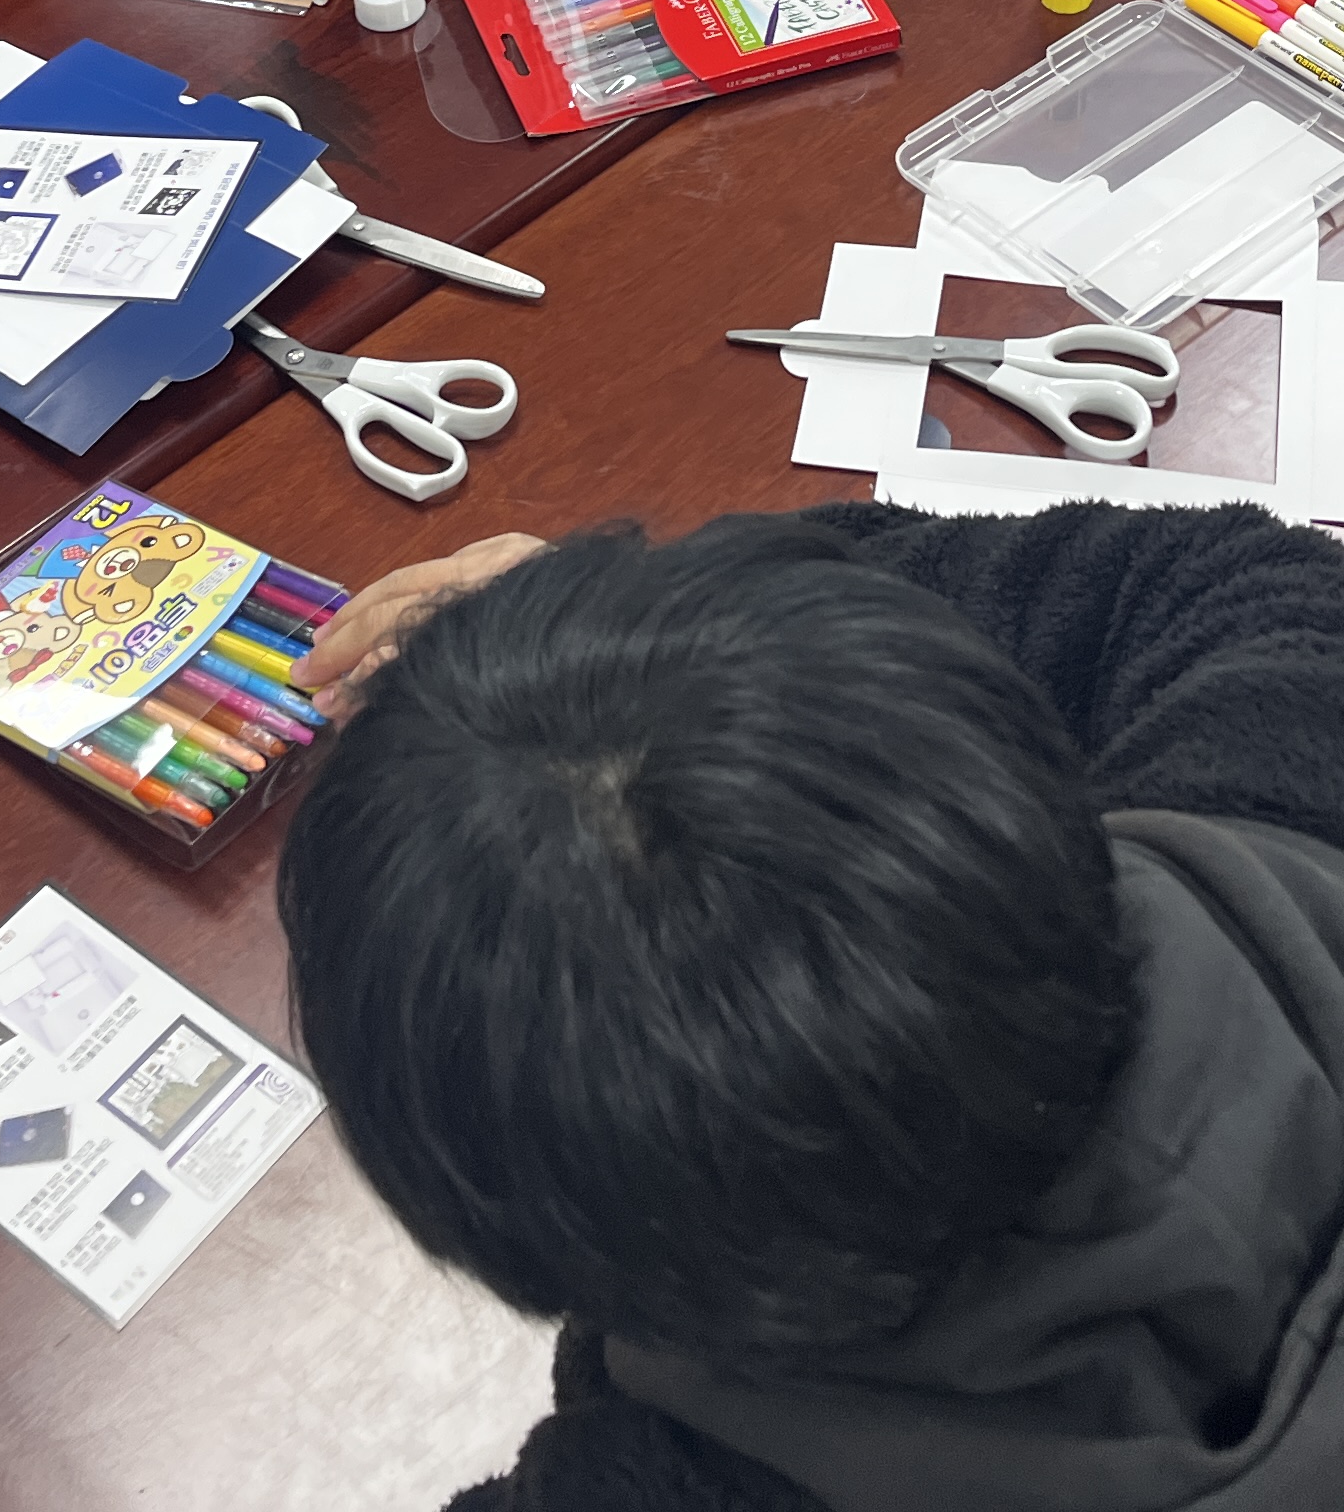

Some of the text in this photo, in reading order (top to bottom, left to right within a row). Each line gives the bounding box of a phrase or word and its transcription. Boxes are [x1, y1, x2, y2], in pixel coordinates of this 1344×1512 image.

[740, 32, 757, 47] 12
[1294, 53, 1342, 88] namepen
[81, 497, 133, 529] 12
[90, 592, 198, 685] 투명이
[140, 640, 179, 673] 지구
